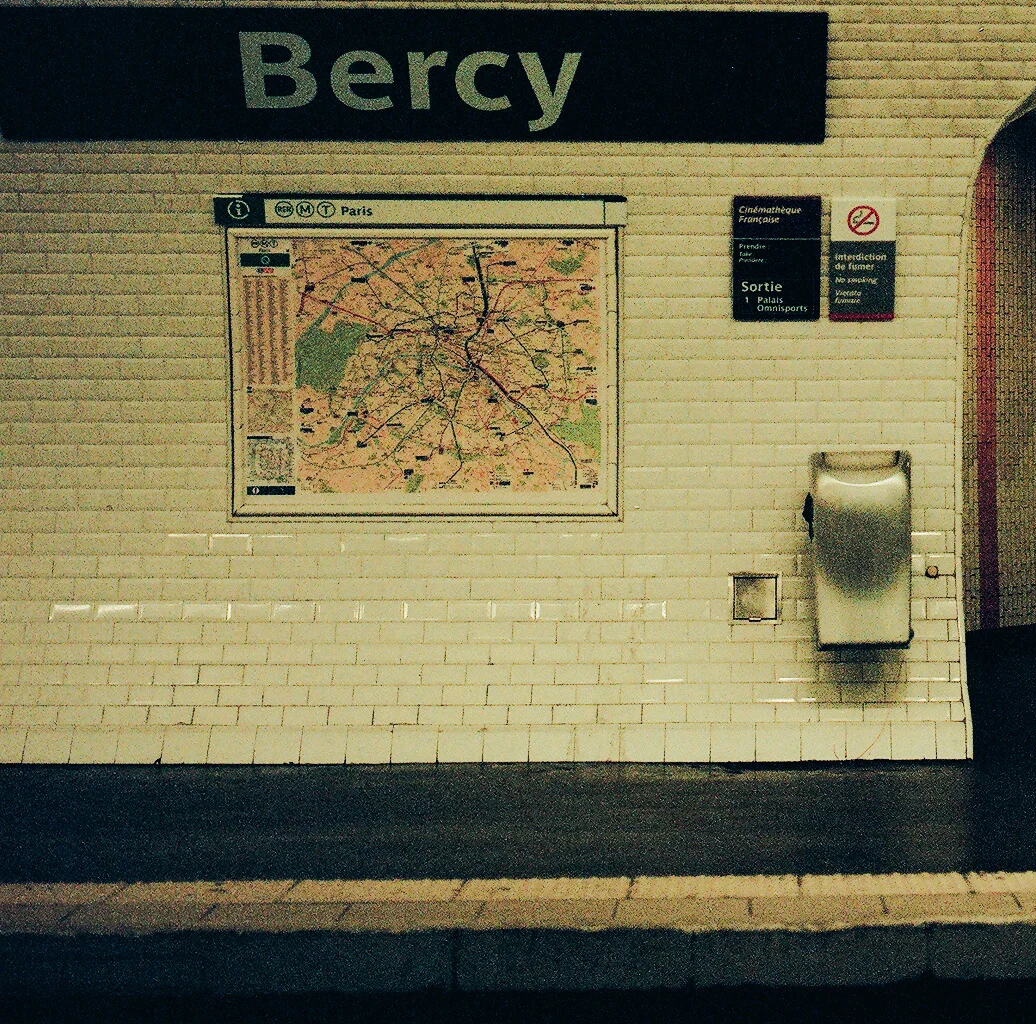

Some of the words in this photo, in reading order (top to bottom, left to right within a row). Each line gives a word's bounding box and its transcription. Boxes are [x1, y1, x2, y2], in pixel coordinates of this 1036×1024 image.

[238, 31, 583, 132] Bercy
[341, 206, 373, 216] Paris
[738, 205, 802, 216] Cinémathèque
[738, 216, 780, 225] Française
[834, 252, 887, 261] Interdiction
[834, 263, 846, 271] de
[848, 263, 875, 271] fumer
[741, 281, 783, 293] Sortie
[757, 296, 783, 304] Palais
[757, 304, 808, 314] Omnisports
